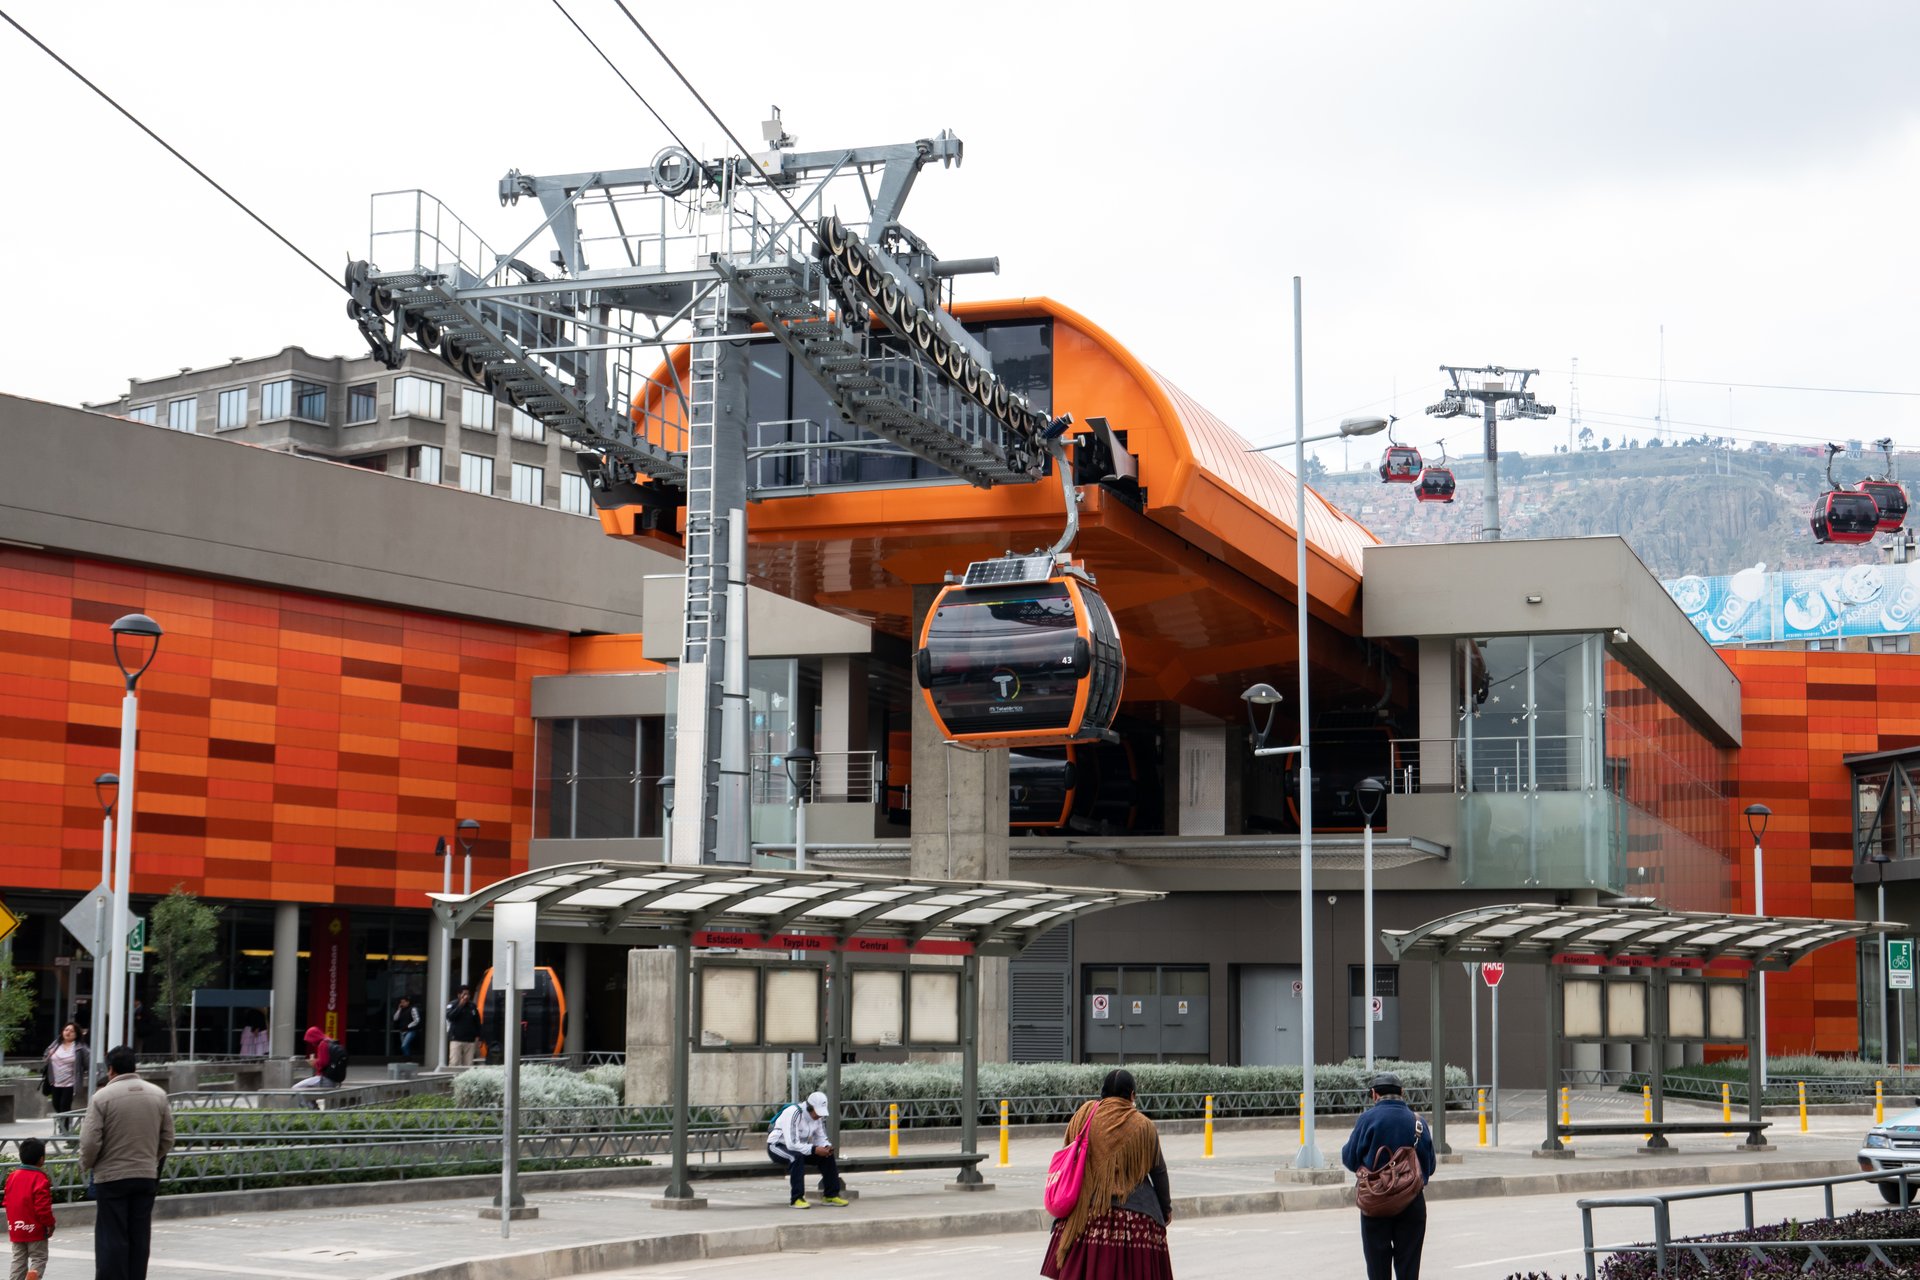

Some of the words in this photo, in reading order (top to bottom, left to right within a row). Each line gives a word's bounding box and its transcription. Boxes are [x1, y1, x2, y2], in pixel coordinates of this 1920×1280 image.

[706, 934, 743, 945] Estación
[783, 937, 804, 948] Taypi
[806, 939, 820, 948] Uta
[860, 940, 888, 950] Central
[1902, 944, 1908, 955] E
[1563, 956, 1589, 964] Estación
[1670, 959, 1691, 967] Central
[328, 945, 337, 1010] Copacabana
[14, 1220, 35, 1233] Paz
